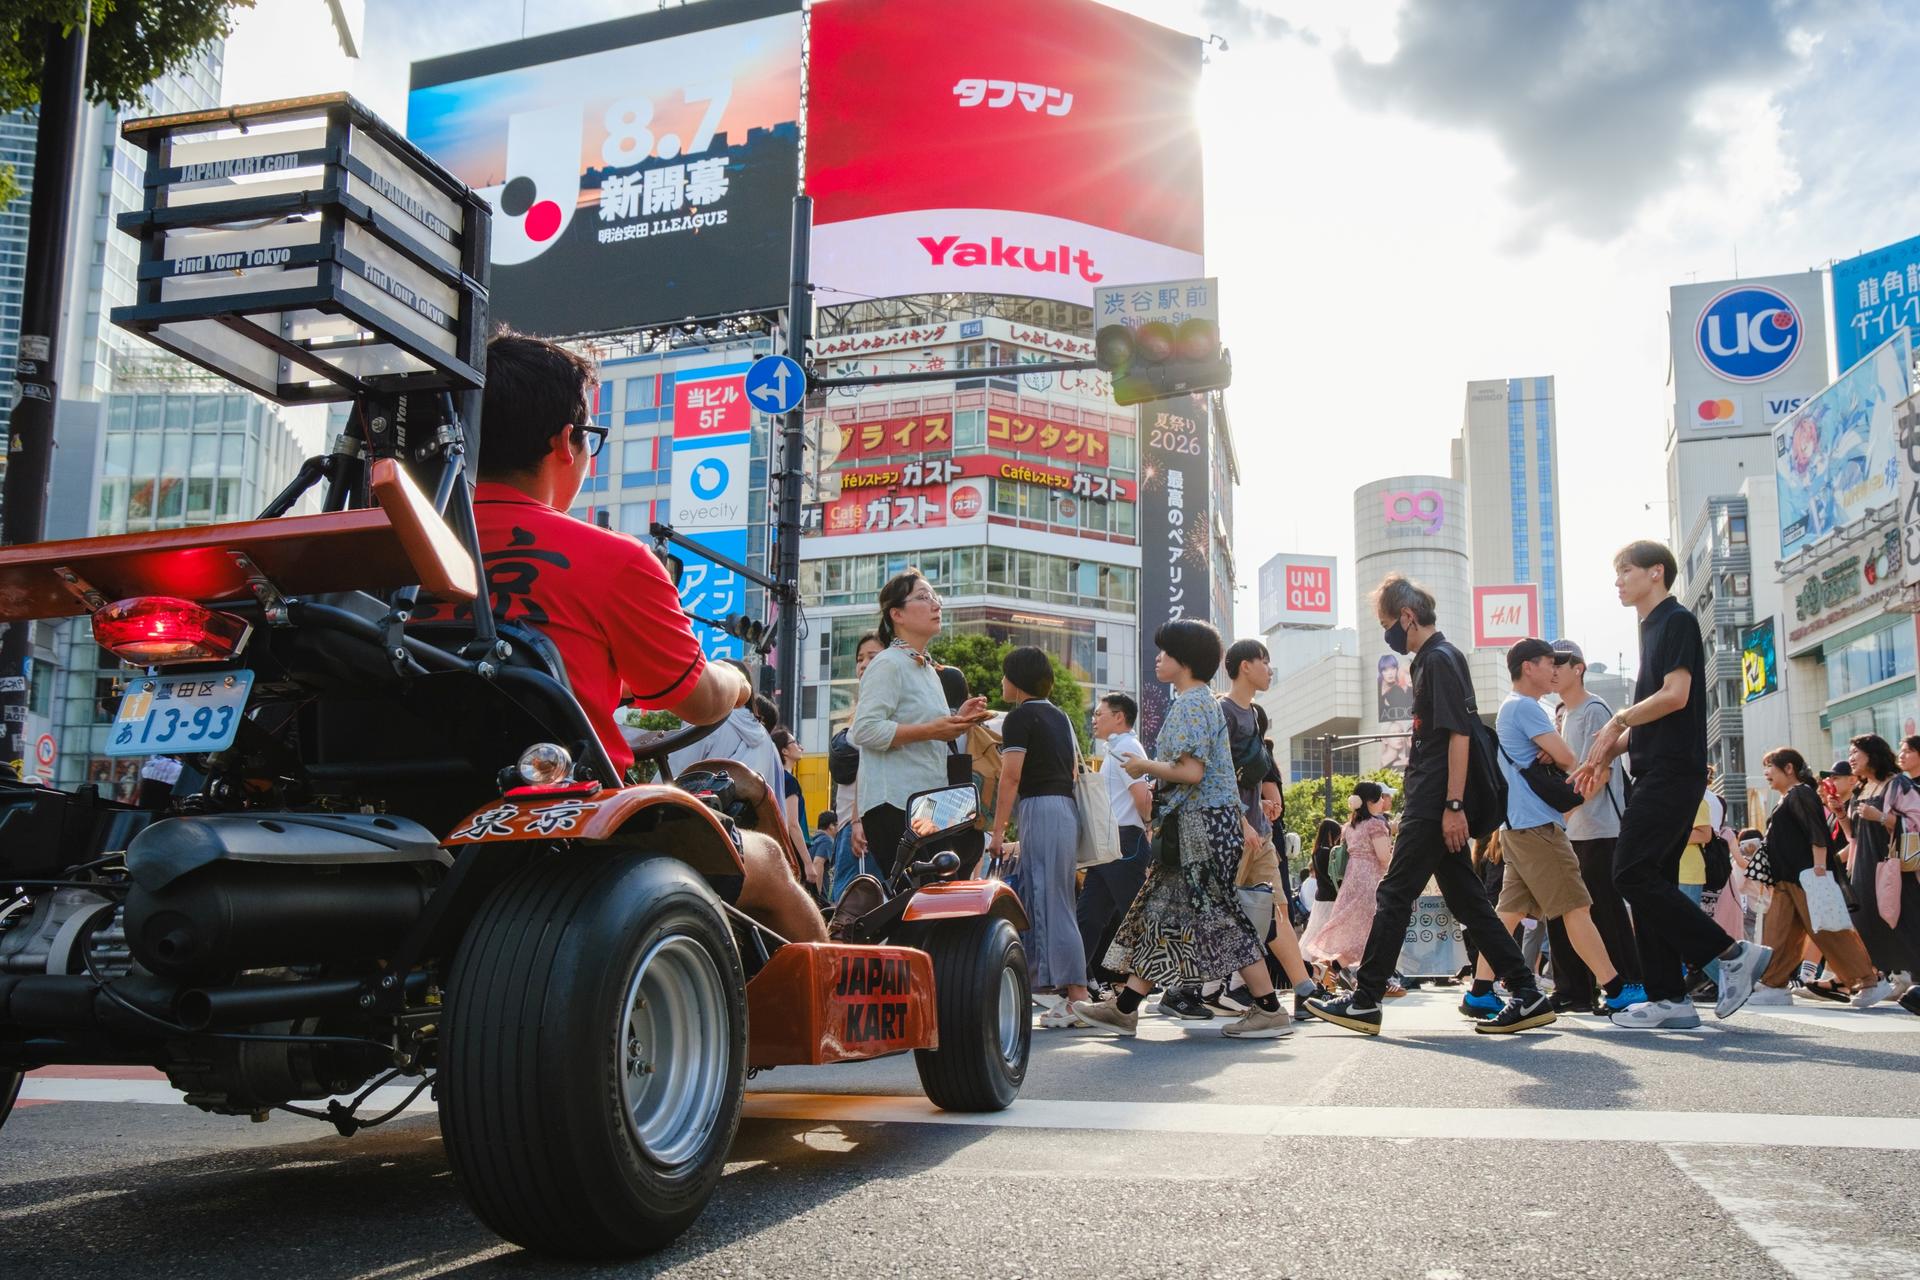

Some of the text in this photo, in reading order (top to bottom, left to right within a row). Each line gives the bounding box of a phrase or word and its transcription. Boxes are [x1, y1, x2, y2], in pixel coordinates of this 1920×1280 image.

[953, 78, 1074, 117] タフマン
[601, 78, 734, 169] 8.7
[180, 153, 298, 182] JAPANKART.com
[598, 156, 730, 222] 新開幕
[370, 170, 450, 241] JAPANKART.com
[598, 209, 729, 245] 明治安田 J.LEAGUE
[174, 247, 291, 274] Find Your Tokyo
[917, 235, 1104, 283] Yakult
[363, 261, 445, 326] Find Your Tokyo
[1104, 286, 1208, 315] 渋谷駅前
[816, 325, 947, 355] しゃぶしゃぶバイキング
[1010, 325, 1096, 354] しゃぶしゃぶバ
[687, 385, 739, 408] 当ビル
[1768, 398, 1810, 415] VIS
[699, 409, 726, 429] 5F
[1155, 412, 1196, 434] 夏祭り
[988, 414, 1105, 457] コンタクト
[1150, 429, 1200, 456] 2026
[903, 460, 963, 487] ガスト
[1072, 472, 1126, 501] ガスト
[679, 501, 739, 523] eyecity
[866, 495, 940, 531] ガスト
[1376, 488, 1444, 536] 109
[1167, 469, 1185, 623] 最高のペアリング
[1290, 570, 1323, 589] UNI
[1290, 589, 1327, 609] QLO
[1491, 605, 1522, 626] H&M
[115, 705, 234, 745] あ 13-93
[451, 800, 599, 840] 東京
[835, 956, 911, 996] JAPAN
[846, 1002, 908, 1043] KART
